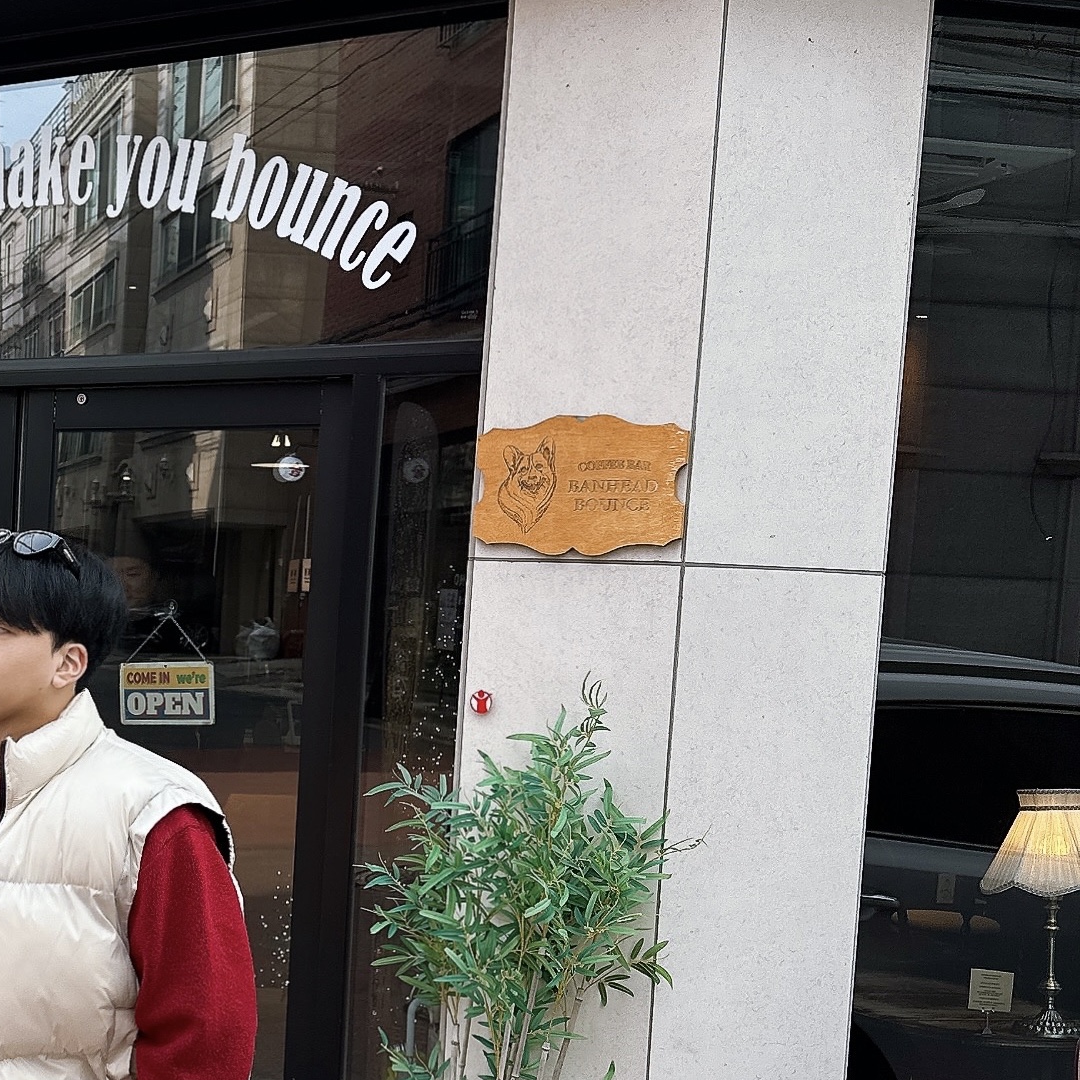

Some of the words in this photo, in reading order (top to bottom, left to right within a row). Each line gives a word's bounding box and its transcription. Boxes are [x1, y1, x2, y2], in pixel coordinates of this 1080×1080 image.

[106, 134, 208, 218] you
[211, 132, 417, 290] bounce
[578, 459, 625, 472] COFFEE
[627, 459, 652, 472] BAR
[567, 479, 659, 493] BANHEAD
[573, 498, 650, 512] BOUNCE
[126, 671, 157, 685] COME
[159, 671, 170, 684] IN
[176, 671, 206, 685] we're
[126, 691, 204, 716] OPEN
